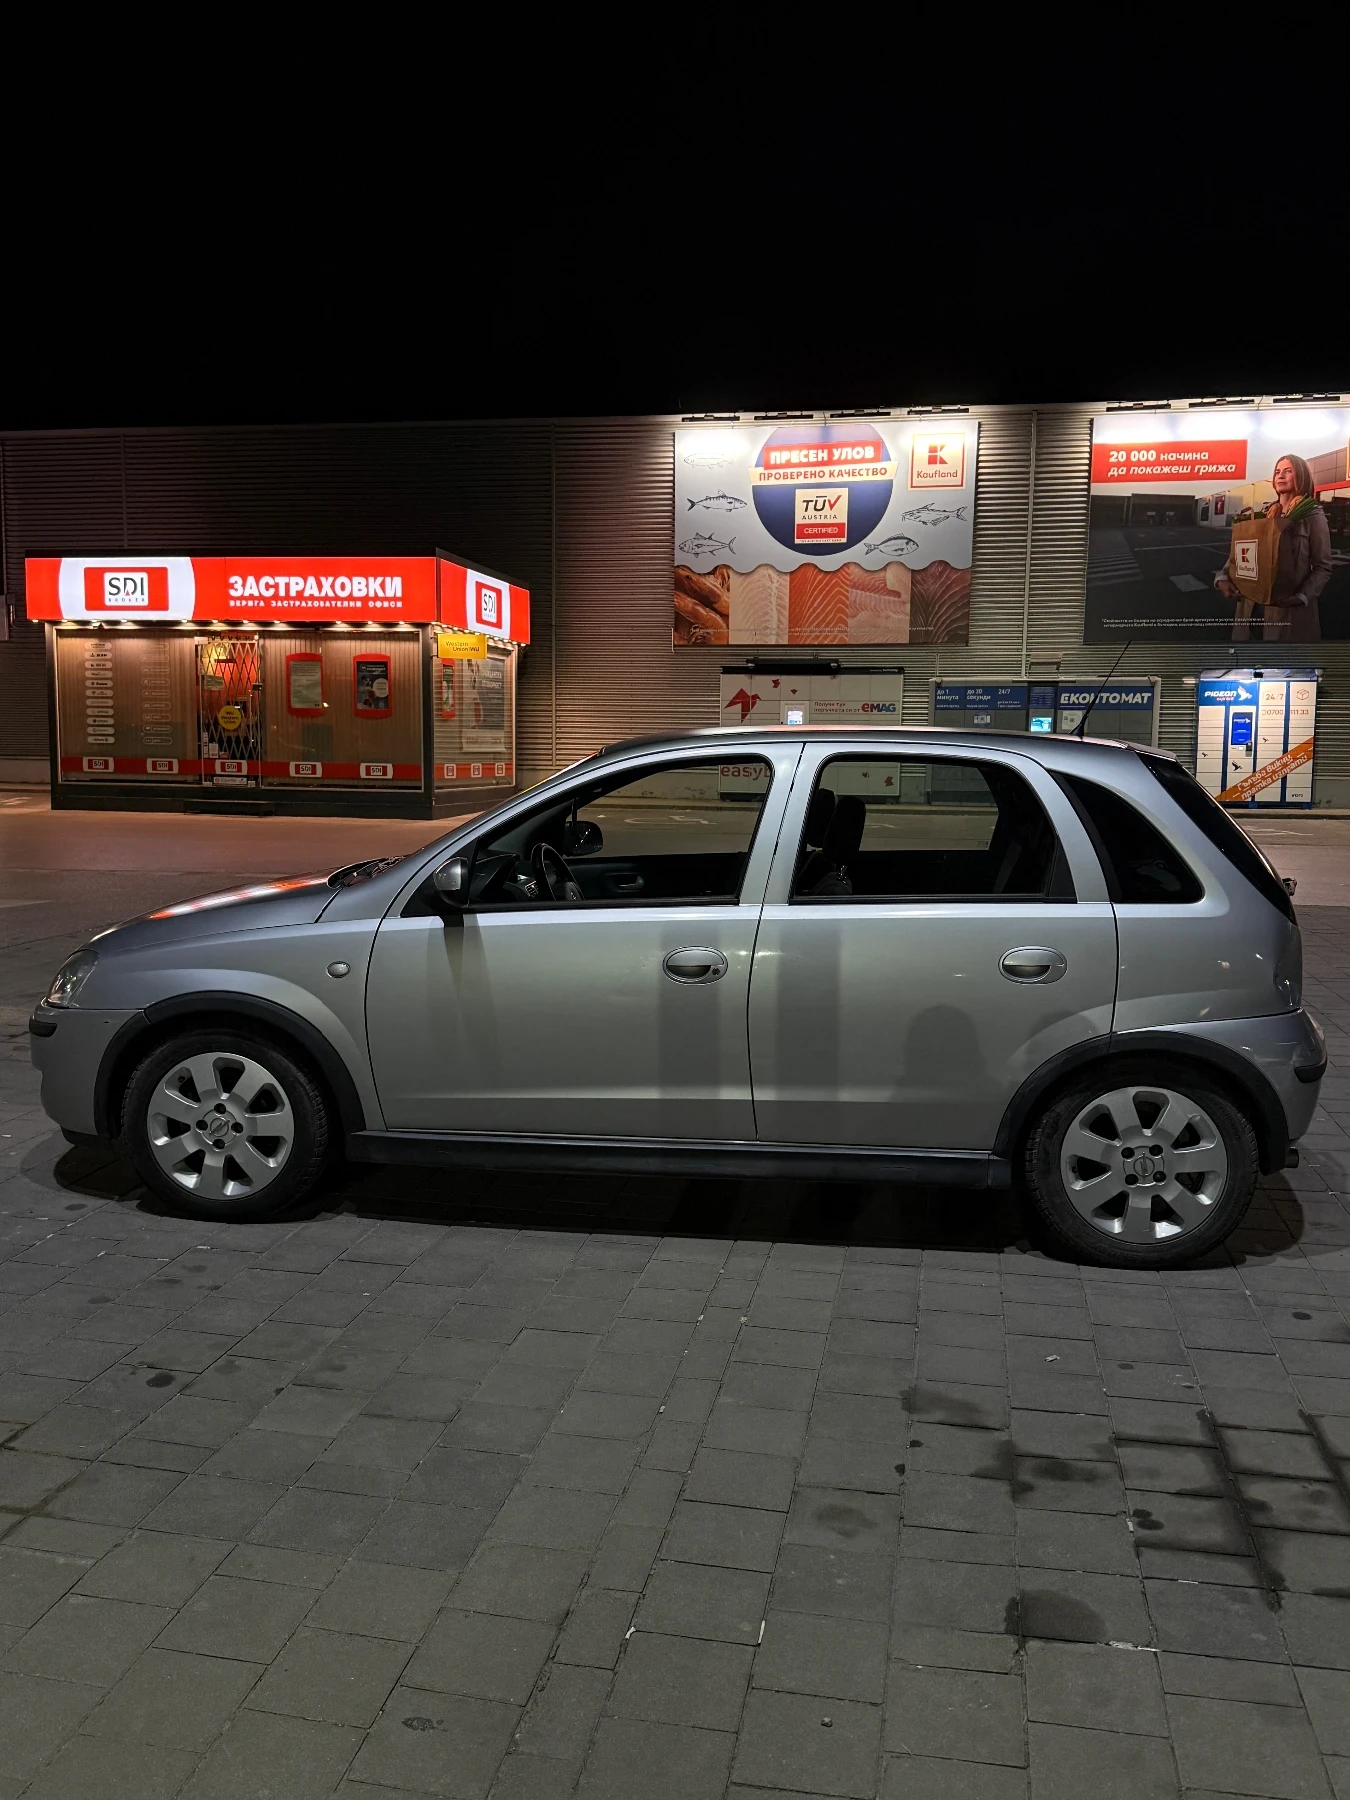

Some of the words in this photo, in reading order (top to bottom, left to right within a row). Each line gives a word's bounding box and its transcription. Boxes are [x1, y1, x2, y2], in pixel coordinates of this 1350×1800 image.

[770, 448, 829, 465] ПРЕСЕН
[832, 445, 875, 461] УЛОВ
[1109, 451, 1127, 462] 20
[1130, 450, 1157, 462] 000
[1160, 451, 1209, 461] начина
[759, 469, 826, 482] ПРОВЕРЕНО
[829, 466, 888, 479] КАЧЕСТВО
[916, 470, 958, 479] Kaufland
[1108, 466, 1127, 477] да
[1129, 464, 1192, 475] покажеш
[1193, 464, 1236, 476] грижа
[108, 577, 145, 596] SDI
[228, 575, 402, 598] ЗАСТРАХОВКИ
[271, 600, 362, 608] ЗАСТРАХОВАТЕЛНИ
[483, 593, 496, 613] SDI
[1265, 693, 1284, 701] 24/7
[861, 703, 896, 712] eMAG
[1236, 770, 1266, 791] Гълъба
[1241, 778, 1272, 800] пратка
